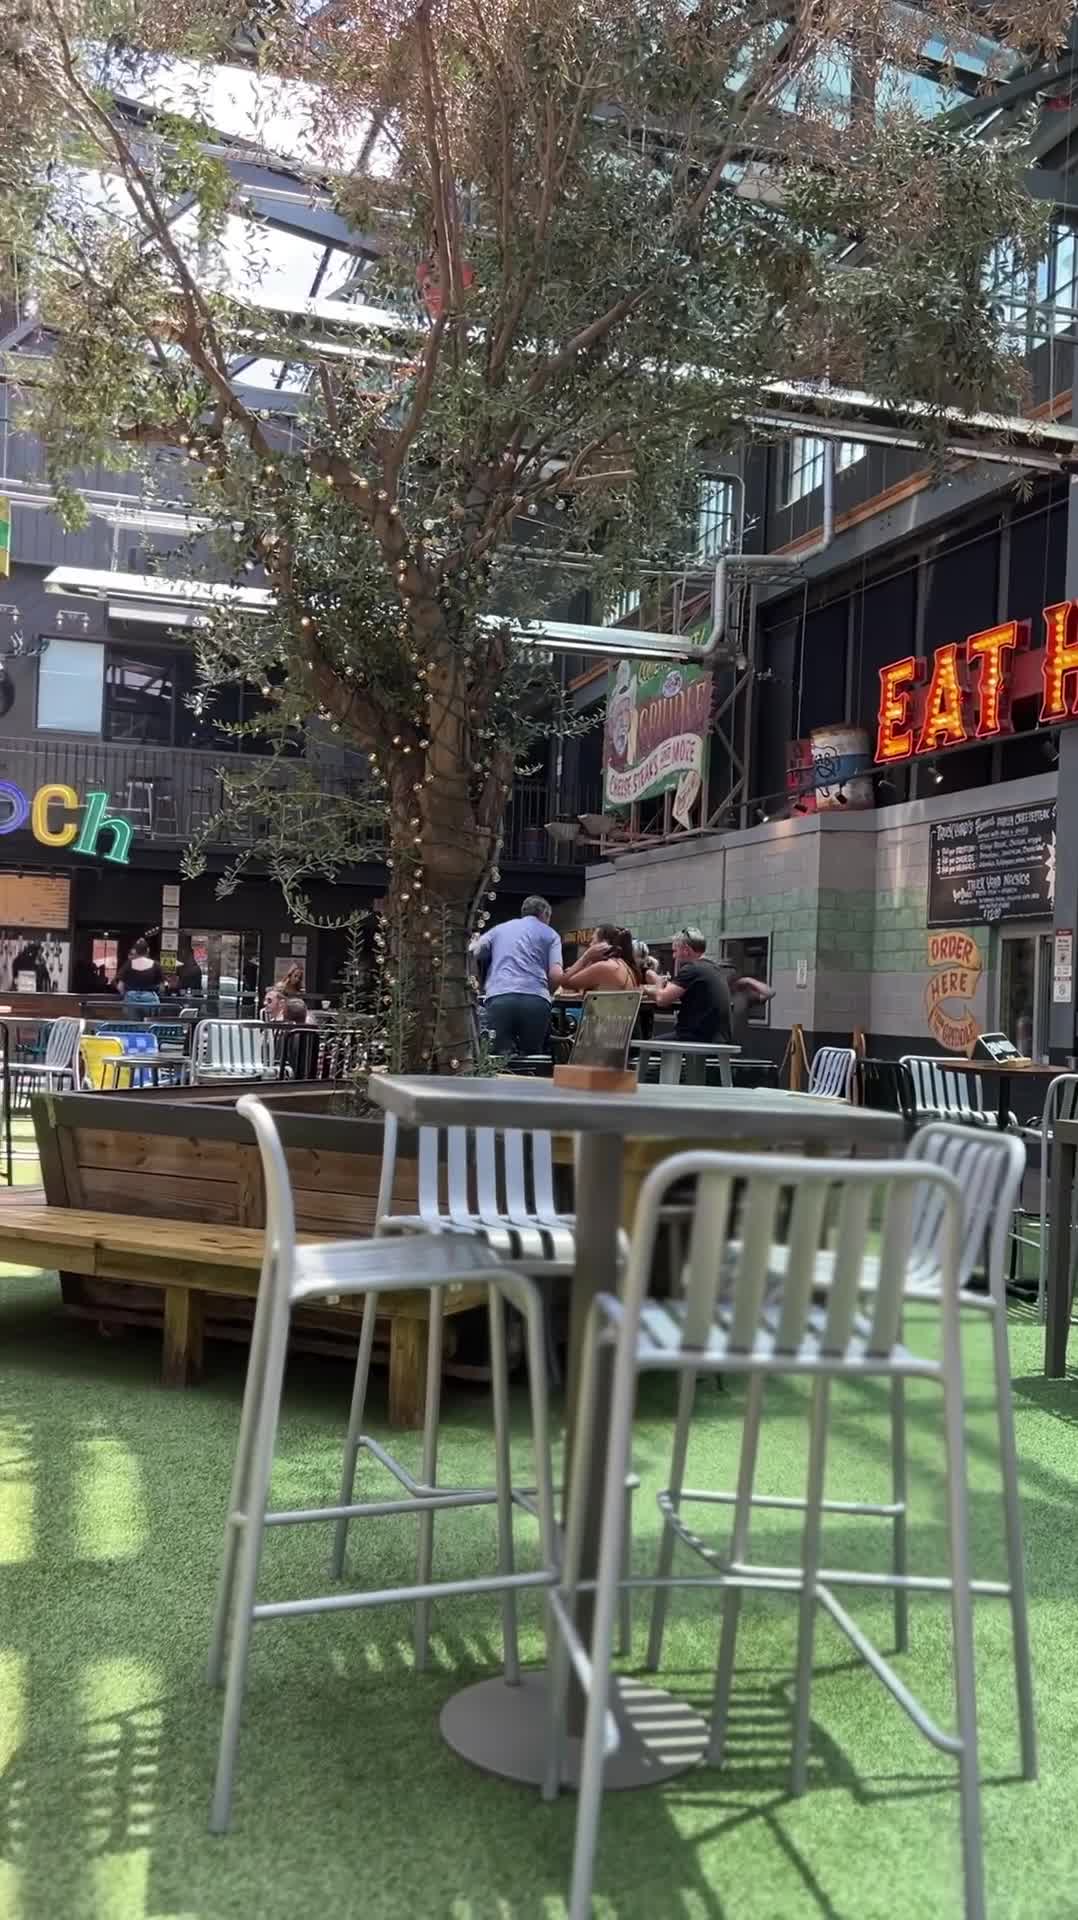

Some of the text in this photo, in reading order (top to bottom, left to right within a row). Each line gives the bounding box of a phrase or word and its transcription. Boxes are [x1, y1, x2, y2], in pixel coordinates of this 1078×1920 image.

[874, 620, 1018, 763] EAT
[671, 739, 696, 763] MORE
[931, 935, 973, 964] ORDER
[931, 973, 968, 1001] HERE
